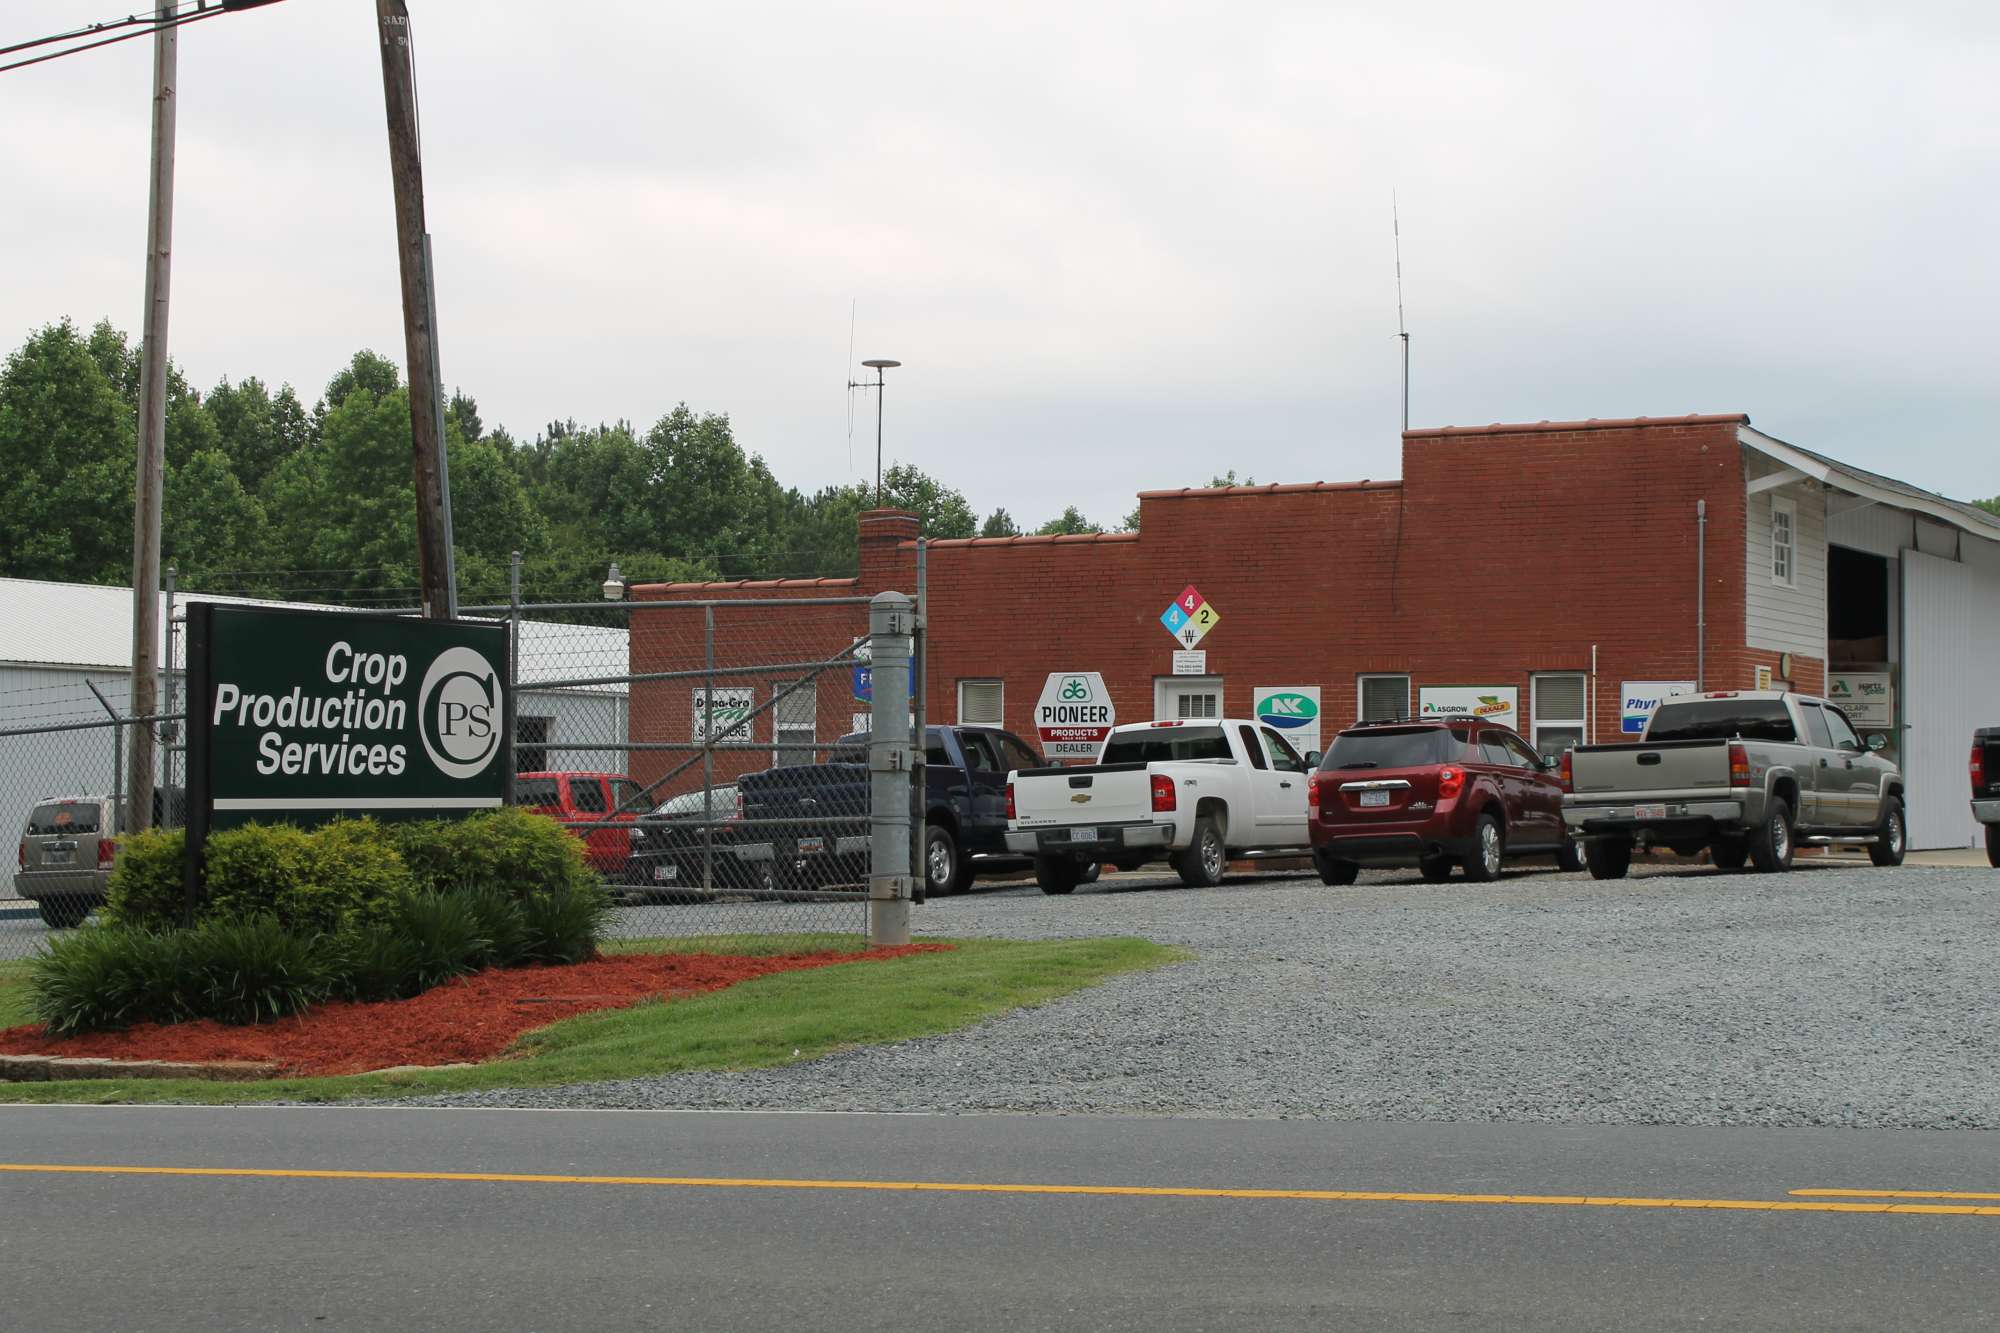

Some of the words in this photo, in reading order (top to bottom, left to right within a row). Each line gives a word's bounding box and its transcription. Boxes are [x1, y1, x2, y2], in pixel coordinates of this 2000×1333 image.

[1184, 594, 1195, 609] 4
[1169, 610, 1179, 625] 4
[1200, 610, 1209, 624] 2
[325, 641, 407, 695] Crop
[213, 683, 406, 730] Production
[696, 697, 750, 708] Dna-Gro
[1271, 698, 1304, 714] NK
[1437, 705, 1467, 713] ASGROW
[1042, 705, 1108, 723] PIONEER
[256, 731, 407, 776] Services
[1056, 744, 1093, 752] DEALER
